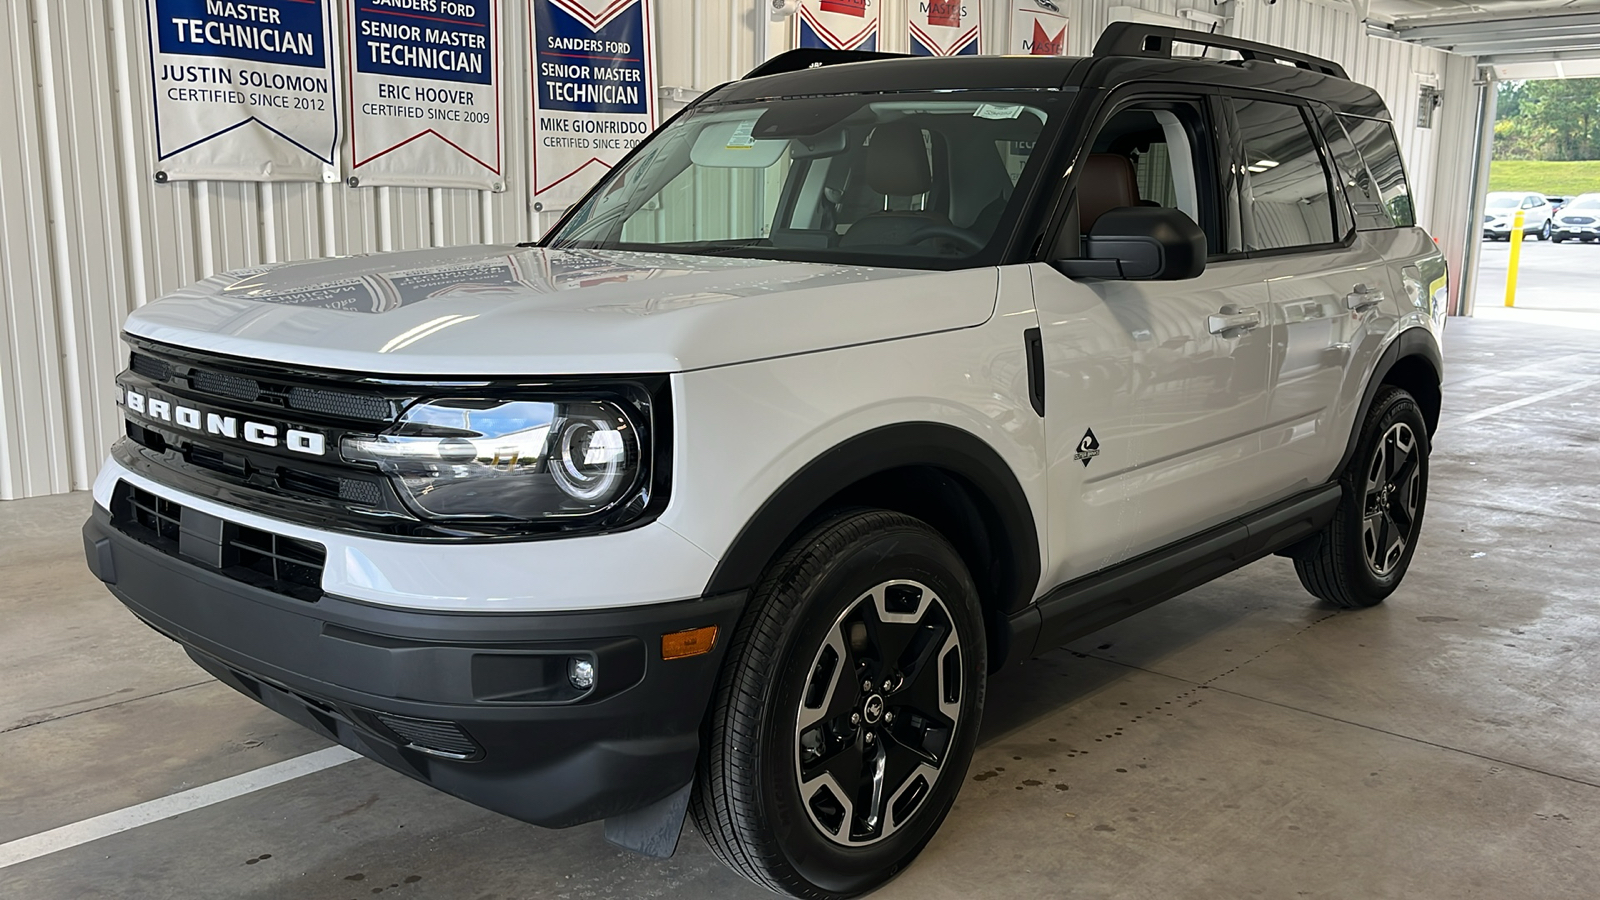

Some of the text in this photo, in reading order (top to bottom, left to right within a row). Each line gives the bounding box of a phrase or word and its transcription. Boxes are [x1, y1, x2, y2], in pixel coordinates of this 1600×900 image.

[206, 0, 281, 24] MASTER
[440, 1, 476, 18] FORD
[172, 18, 314, 56] TECHNICIAN
[360, 20, 486, 50] SENIOR MASTER
[548, 36, 631, 54] SANDERS FORD
[367, 41, 482, 74] TECHNICIAN
[161, 64, 328, 94] JUSTIN SOLOMON
[541, 62, 641, 82] SENIOR MASTER
[167, 87, 326, 111] CERTIFIED SINCE 2012
[378, 83, 474, 106] ERIC HOOVER
[546, 81, 639, 105] TECHNICIAN
[362, 103, 490, 124] CERTIFIED SINCE 2009
[540, 117, 648, 134] MIKE GIONFRIDDO
[543, 137, 590, 149] CERTIFIED
[592, 138, 621, 149] SINCE
[127, 390, 326, 456] BRONCO
